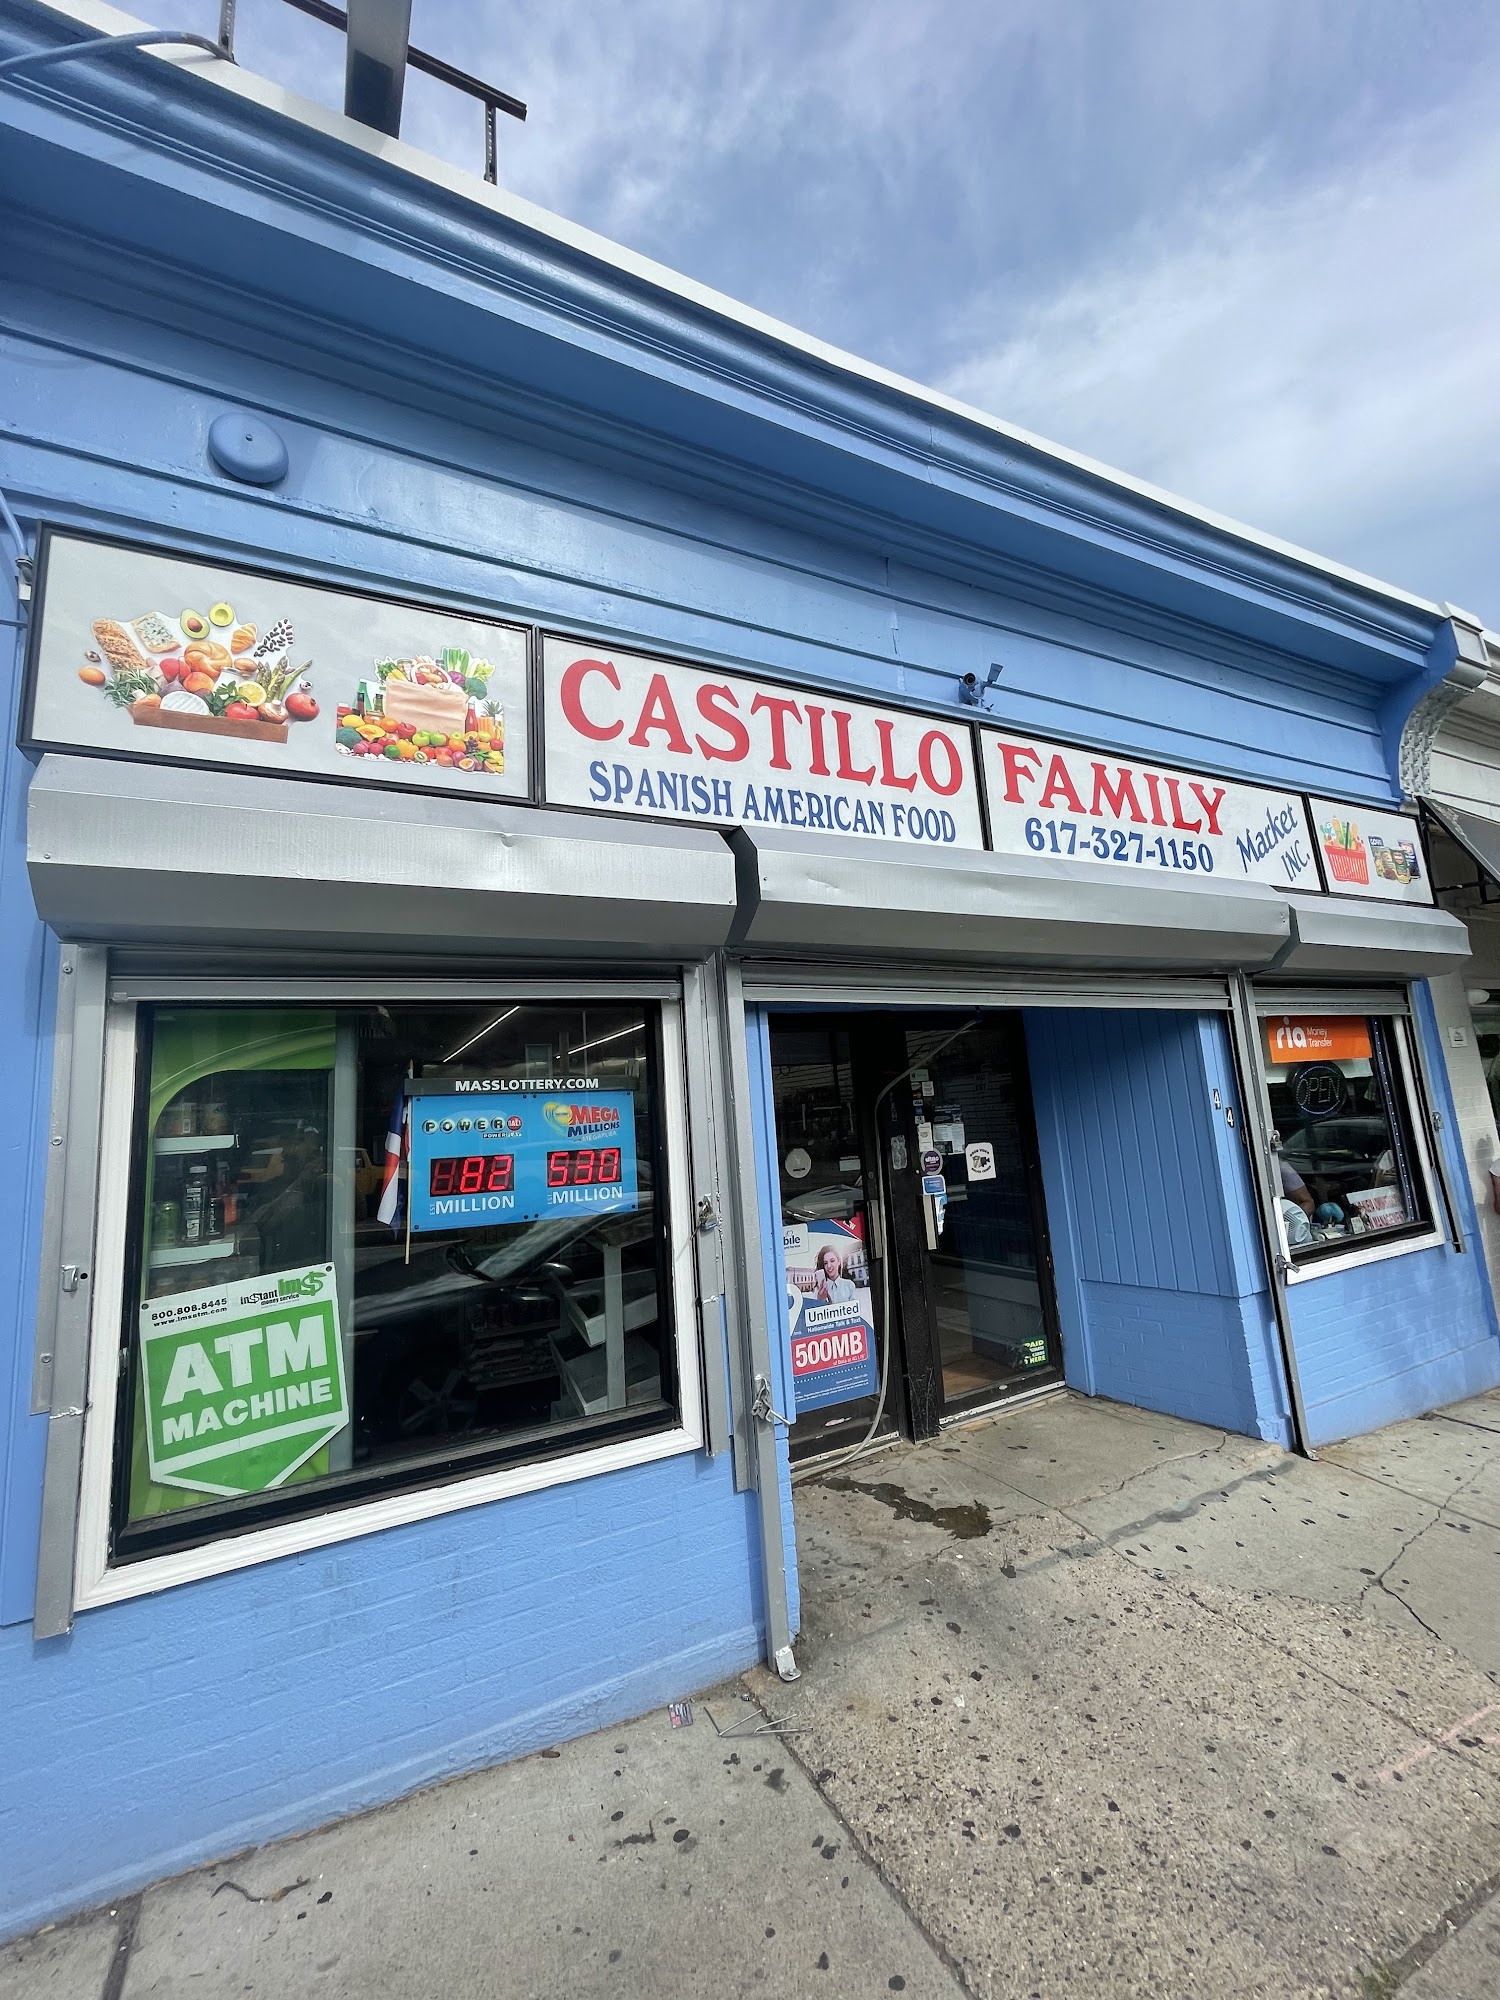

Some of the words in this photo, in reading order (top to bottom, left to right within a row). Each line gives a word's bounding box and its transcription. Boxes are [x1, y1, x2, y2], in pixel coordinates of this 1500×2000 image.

[560, 658, 963, 796] CASTILLO
[589, 760, 733, 818] SPANISH
[743, 783, 886, 836] AMERICAN
[891, 803, 956, 843] FOOD
[998, 742, 1226, 836] FAMILY
[1025, 817, 1214, 873] 617-327-1150
[1236, 802, 1298, 873] Market
[1281, 841, 1311, 883] INC.
[1276, 1016, 1307, 1049] ria
[1306, 1027, 1328, 1038] Money
[1308, 1038, 1333, 1048] Transfer
[455, 1078, 599, 1092] MASSLOTTERY.COM
[1296, 1076, 1341, 1106] OPEN
[567, 1121, 620, 1138] MILLIONS
[571, 1104, 620, 1125] MEGA
[547, 1148, 619, 1186] 530
[435, 1196, 515, 1215] MILLION
[552, 1186, 623, 1204] MILLION
[151, 1297, 227, 1321] 800.808.8445
[808, 1302, 859, 1323] Unlimited
[161, 1314, 327, 1407] ATM
[795, 1331, 863, 1368] 500MB
[162, 1377, 333, 1445] MACHINE
